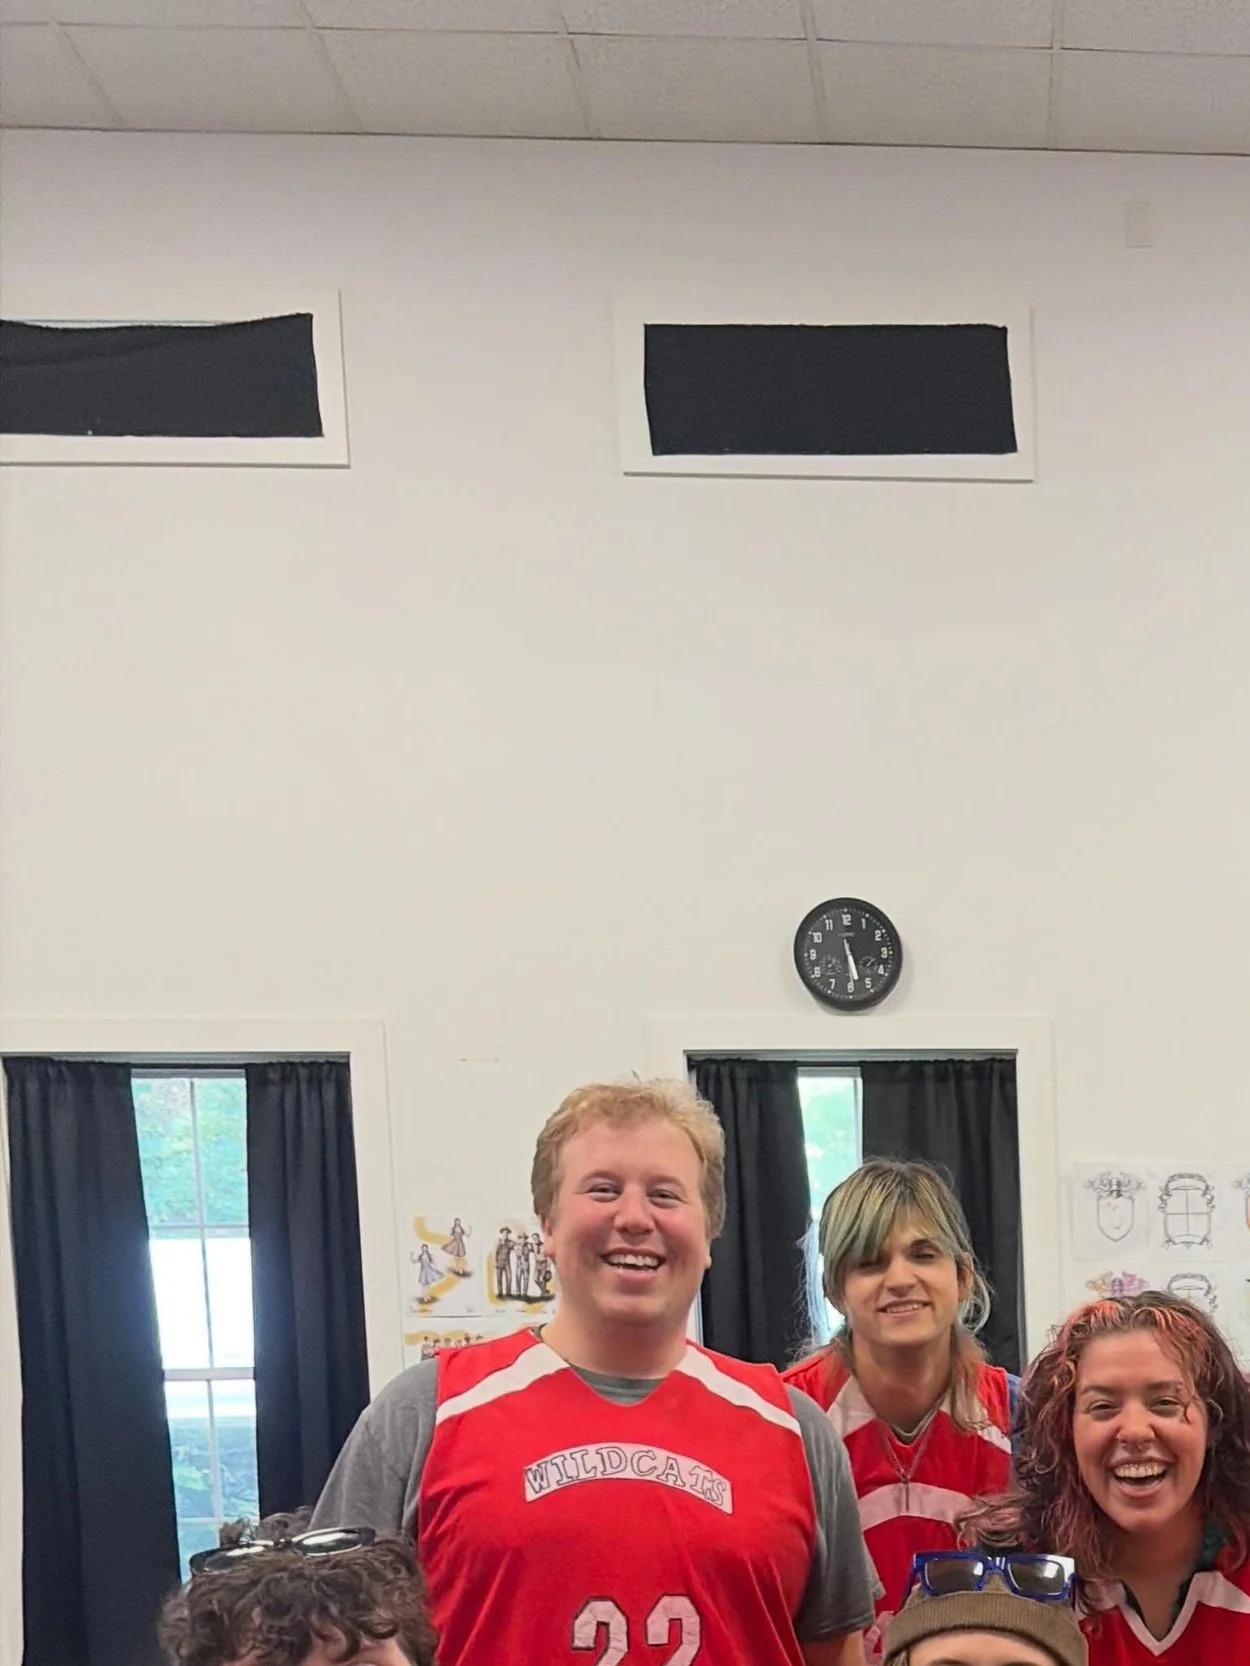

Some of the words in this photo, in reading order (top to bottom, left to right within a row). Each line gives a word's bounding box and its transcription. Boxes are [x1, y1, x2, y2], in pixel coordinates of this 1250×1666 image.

[825, 919, 834, 931] 11
[841, 913, 852, 926] 12
[812, 932, 823, 943] 10
[874, 929, 882, 941] 2
[880, 947, 888, 959] 3
[877, 964, 885, 975] 4
[829, 978, 836, 990] 7
[865, 977, 872, 989] 5
[525, 1446, 727, 1506] WILDCATS
